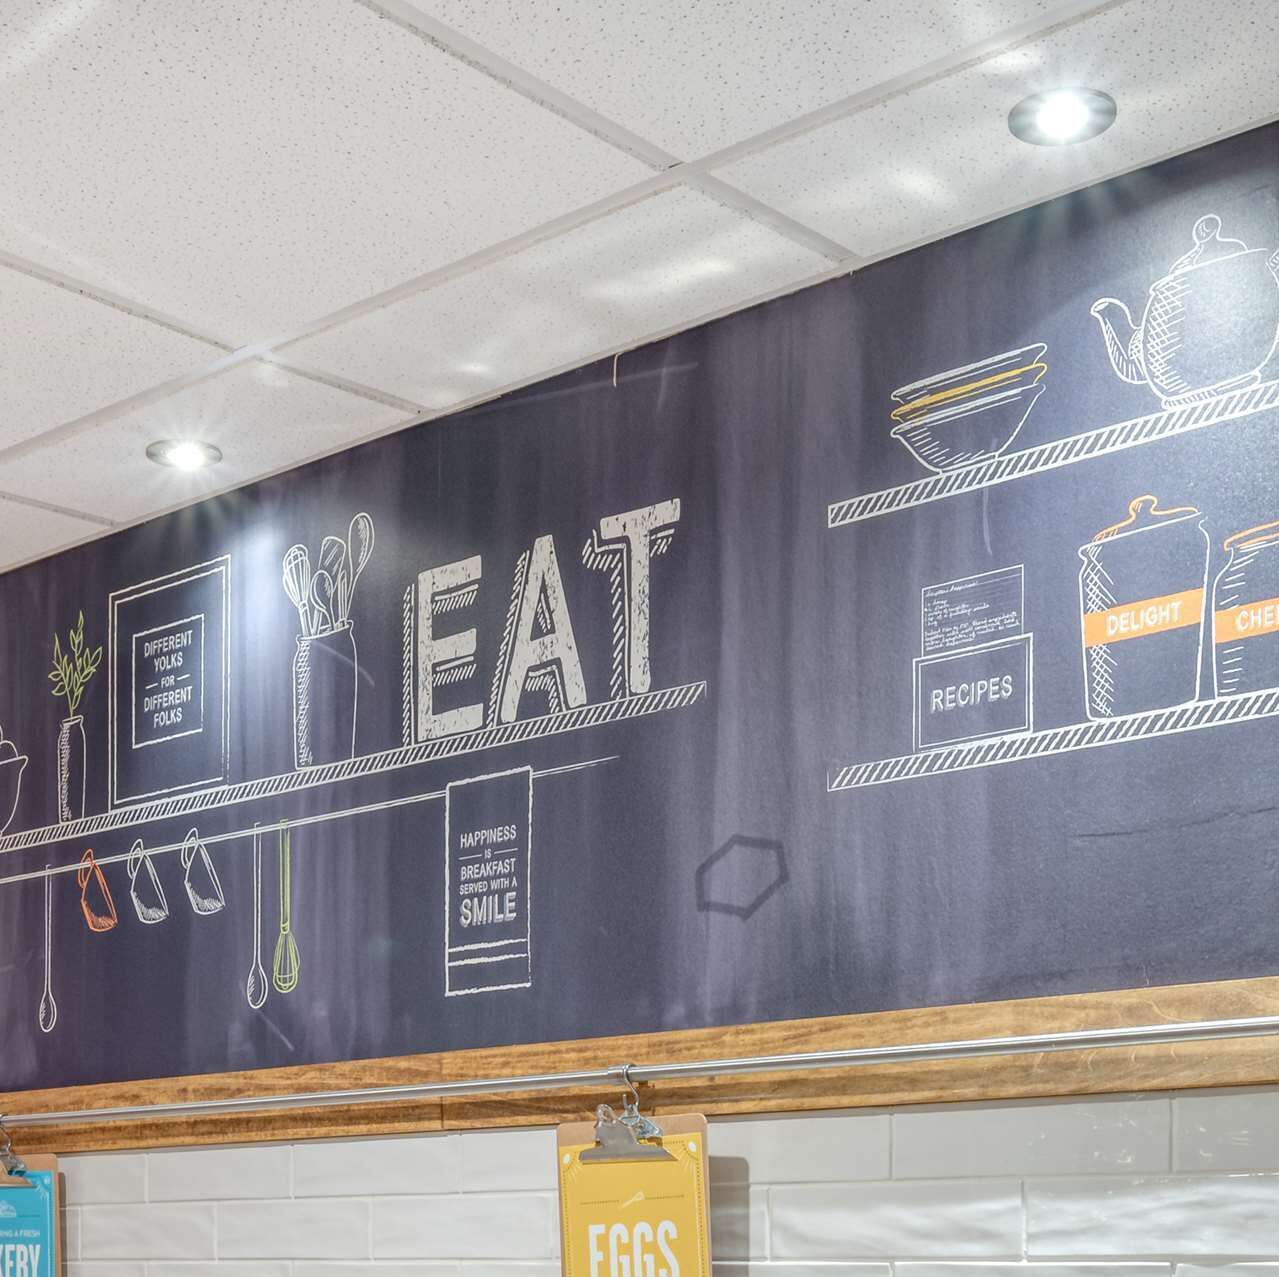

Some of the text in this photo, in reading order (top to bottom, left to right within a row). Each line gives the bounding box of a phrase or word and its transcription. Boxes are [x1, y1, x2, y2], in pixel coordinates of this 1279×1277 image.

[403, 498, 681, 745] EAT
[1106, 600, 1183, 636] DELIGHT
[144, 630, 193, 657] DIFFERENT
[154, 651, 183, 672] YOLKS
[161, 674, 175, 688] FOR
[144, 686, 193, 713] DIFFERENT
[930, 676, 1013, 713] RECIPES
[153, 707, 182, 728] FOLKS
[460, 824, 516, 848] HAPPINESS
[484, 848, 491, 858] IS
[460, 858, 516, 881] BREAKFAST
[459, 876, 518, 895] SERVED WITH A
[459, 891, 517, 928] SMILE
